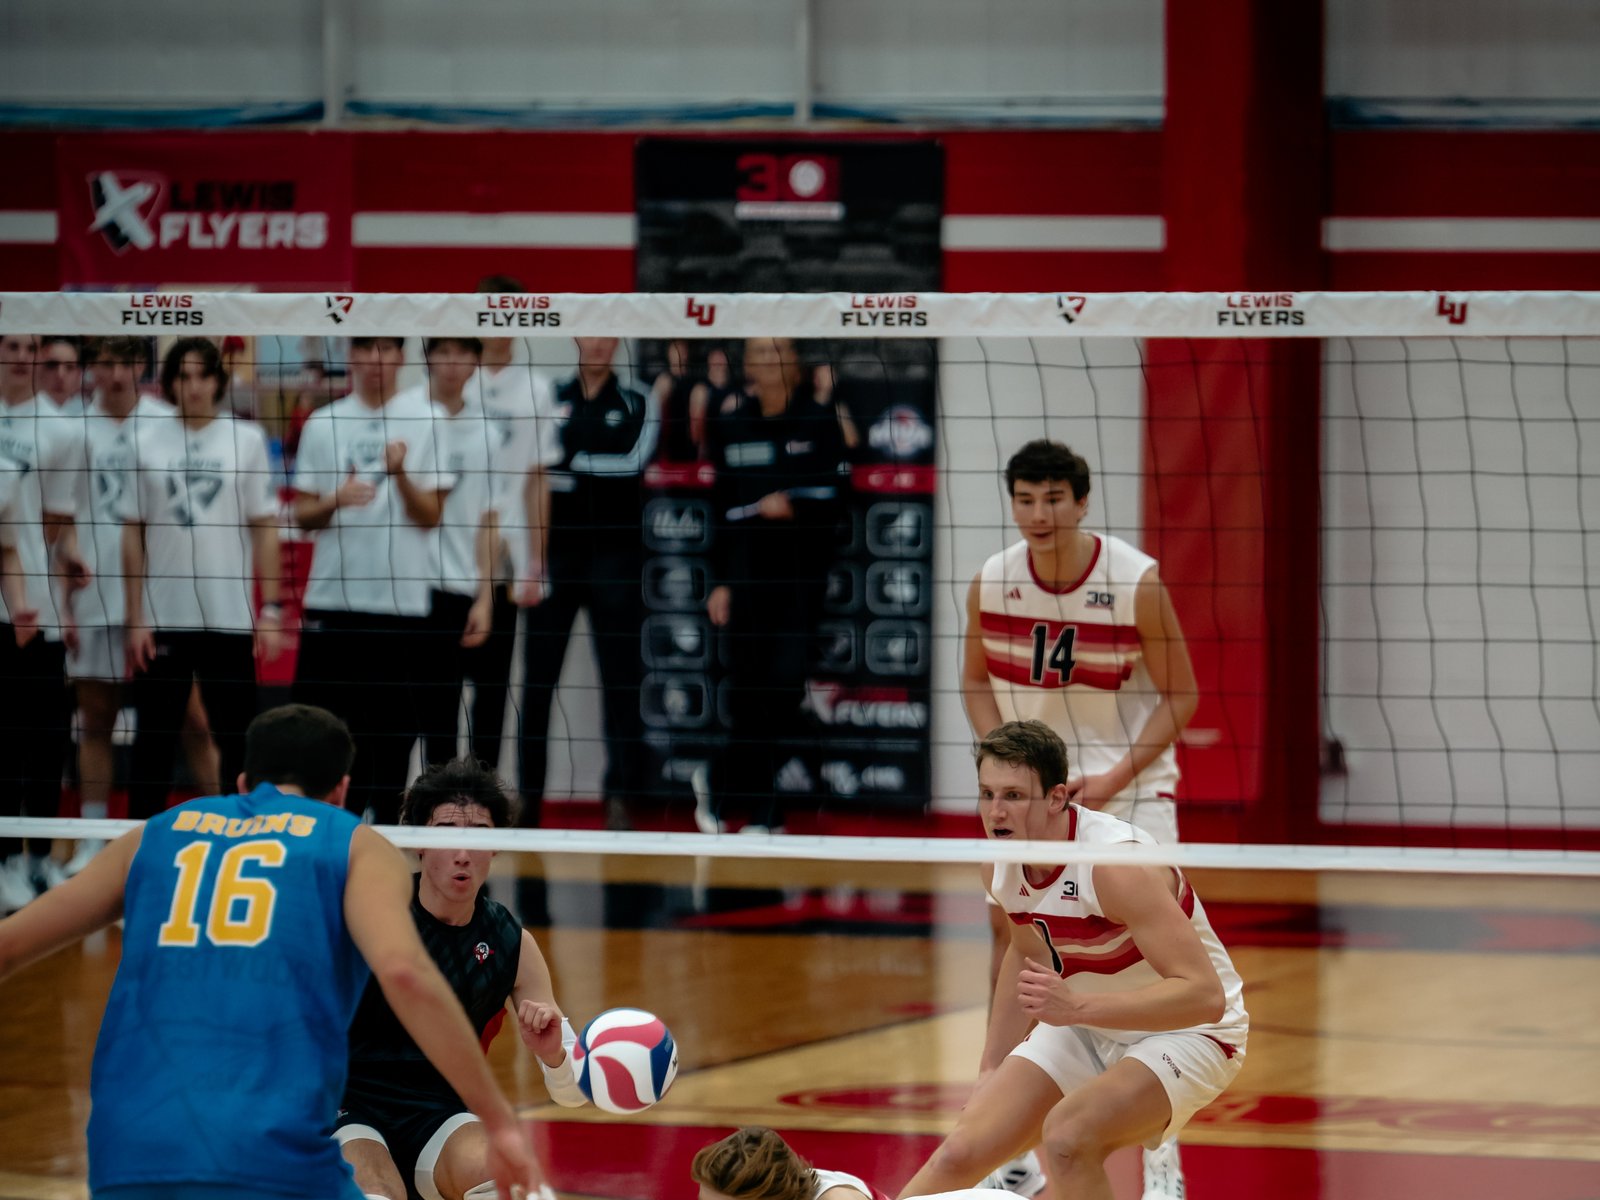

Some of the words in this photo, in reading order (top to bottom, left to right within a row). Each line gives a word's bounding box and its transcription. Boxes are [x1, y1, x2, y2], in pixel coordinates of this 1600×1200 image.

[170, 180, 296, 210] LEWIS
[158, 212, 329, 249] FLYERS
[130, 294, 193, 308] LEWIS
[487, 295, 550, 309] LEWIS
[851, 295, 918, 309] LEWIS
[1226, 293, 1294, 309] LEWIS
[121, 310, 204, 326] FLYERS
[476, 311, 562, 327] FLYERS
[840, 310, 928, 327] FLYERS
[1216, 309, 1305, 326] FLYERS
[1030, 621, 1077, 685] 14
[171, 810, 317, 838] BRUINS
[157, 839, 287, 947] 16
